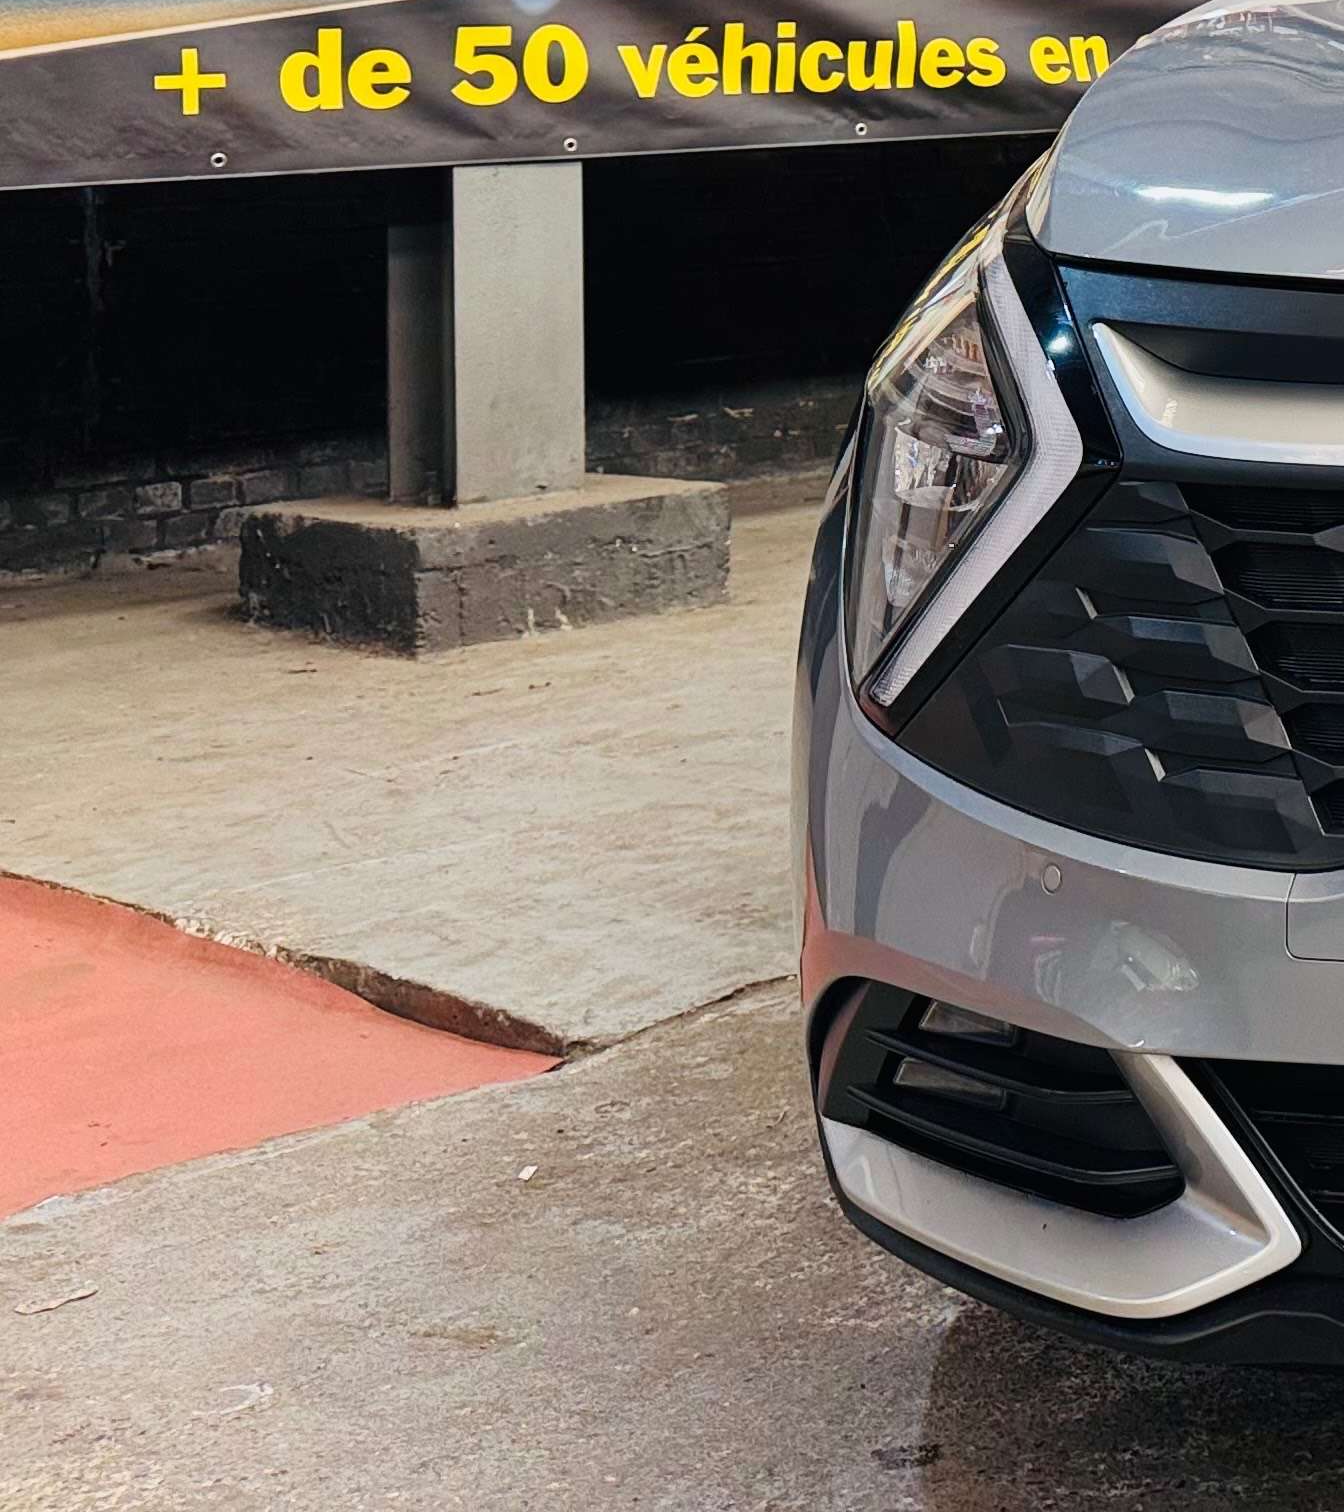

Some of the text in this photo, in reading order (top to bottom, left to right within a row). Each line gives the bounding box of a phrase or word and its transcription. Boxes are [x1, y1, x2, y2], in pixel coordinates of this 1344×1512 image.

[279, 28, 412, 113] de
[452, 23, 589, 106] 50
[619, 20, 1008, 99] véhicules
[1029, 35, 1110, 84] en
